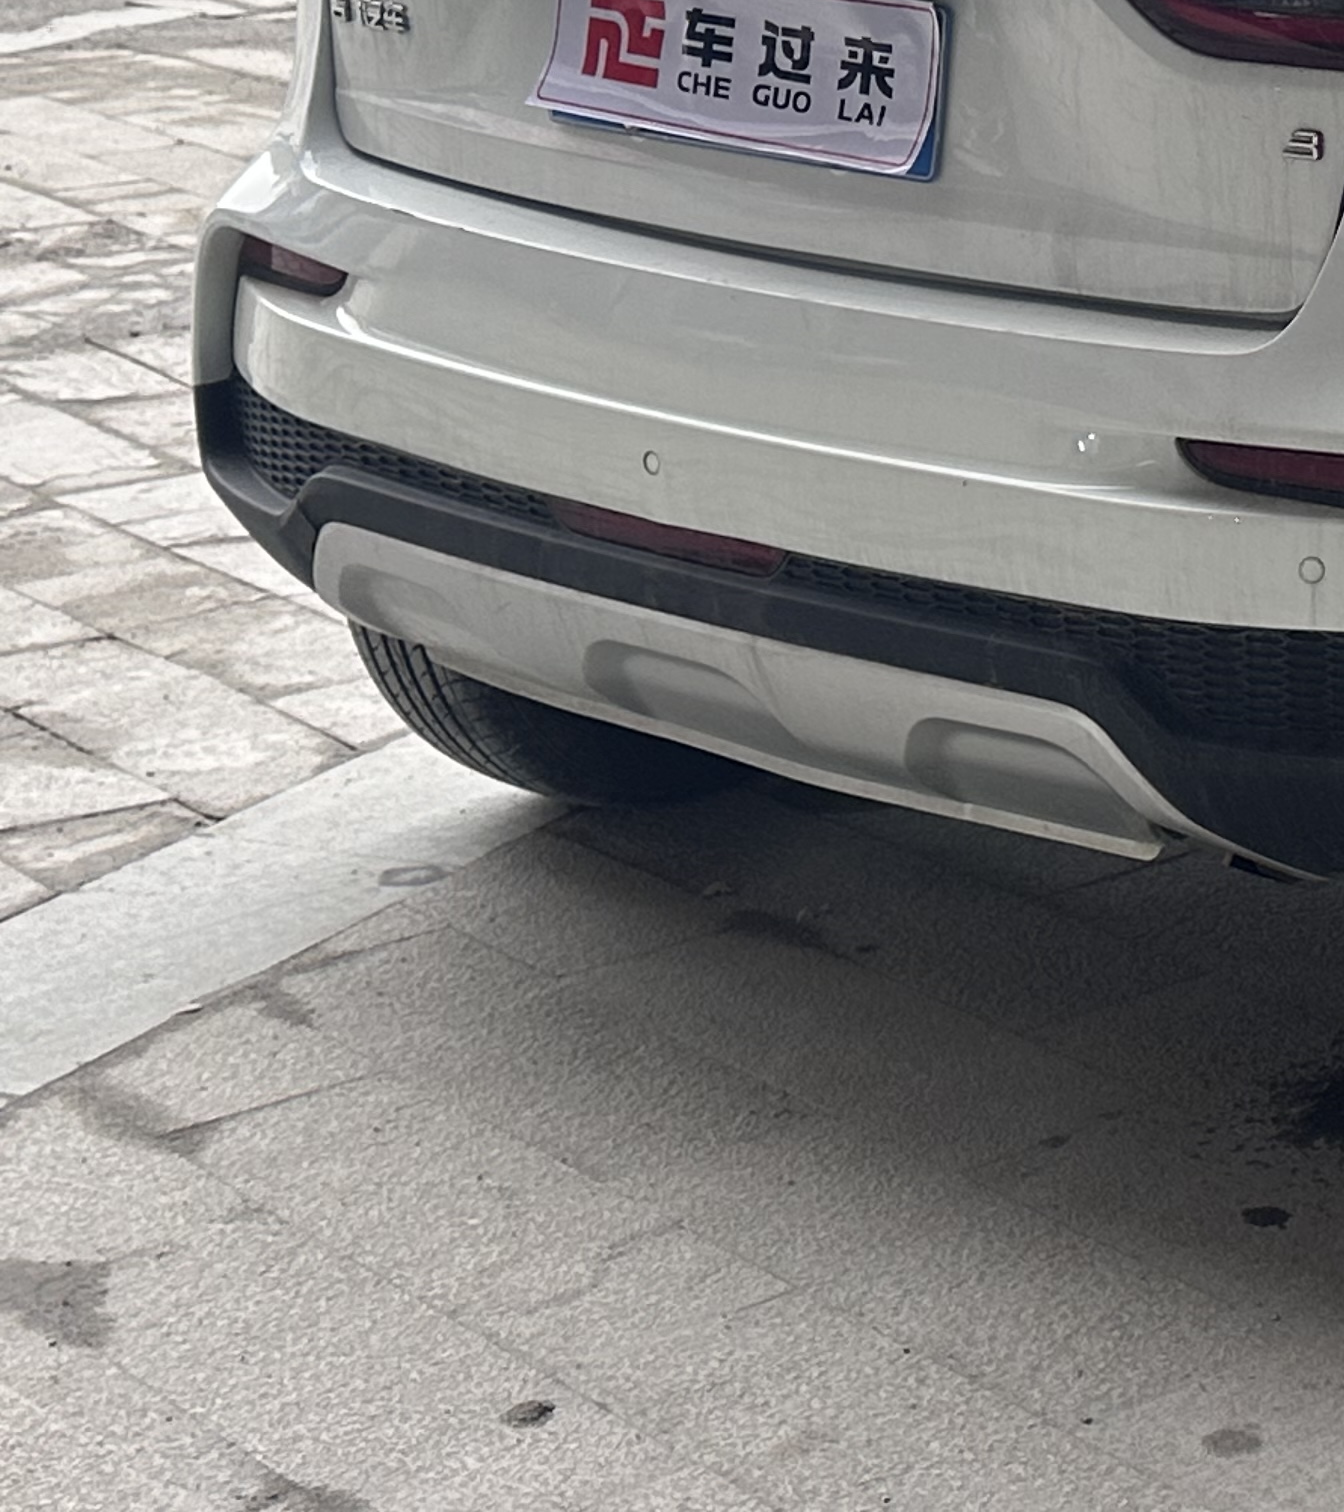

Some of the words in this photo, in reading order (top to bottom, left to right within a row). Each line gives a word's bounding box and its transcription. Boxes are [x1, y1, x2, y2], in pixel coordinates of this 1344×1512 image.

[682, 7, 896, 100] 车过来
[677, 70, 731, 101] CHE
[752, 82, 812, 115] GUO
[837, 97, 887, 128] LAI
